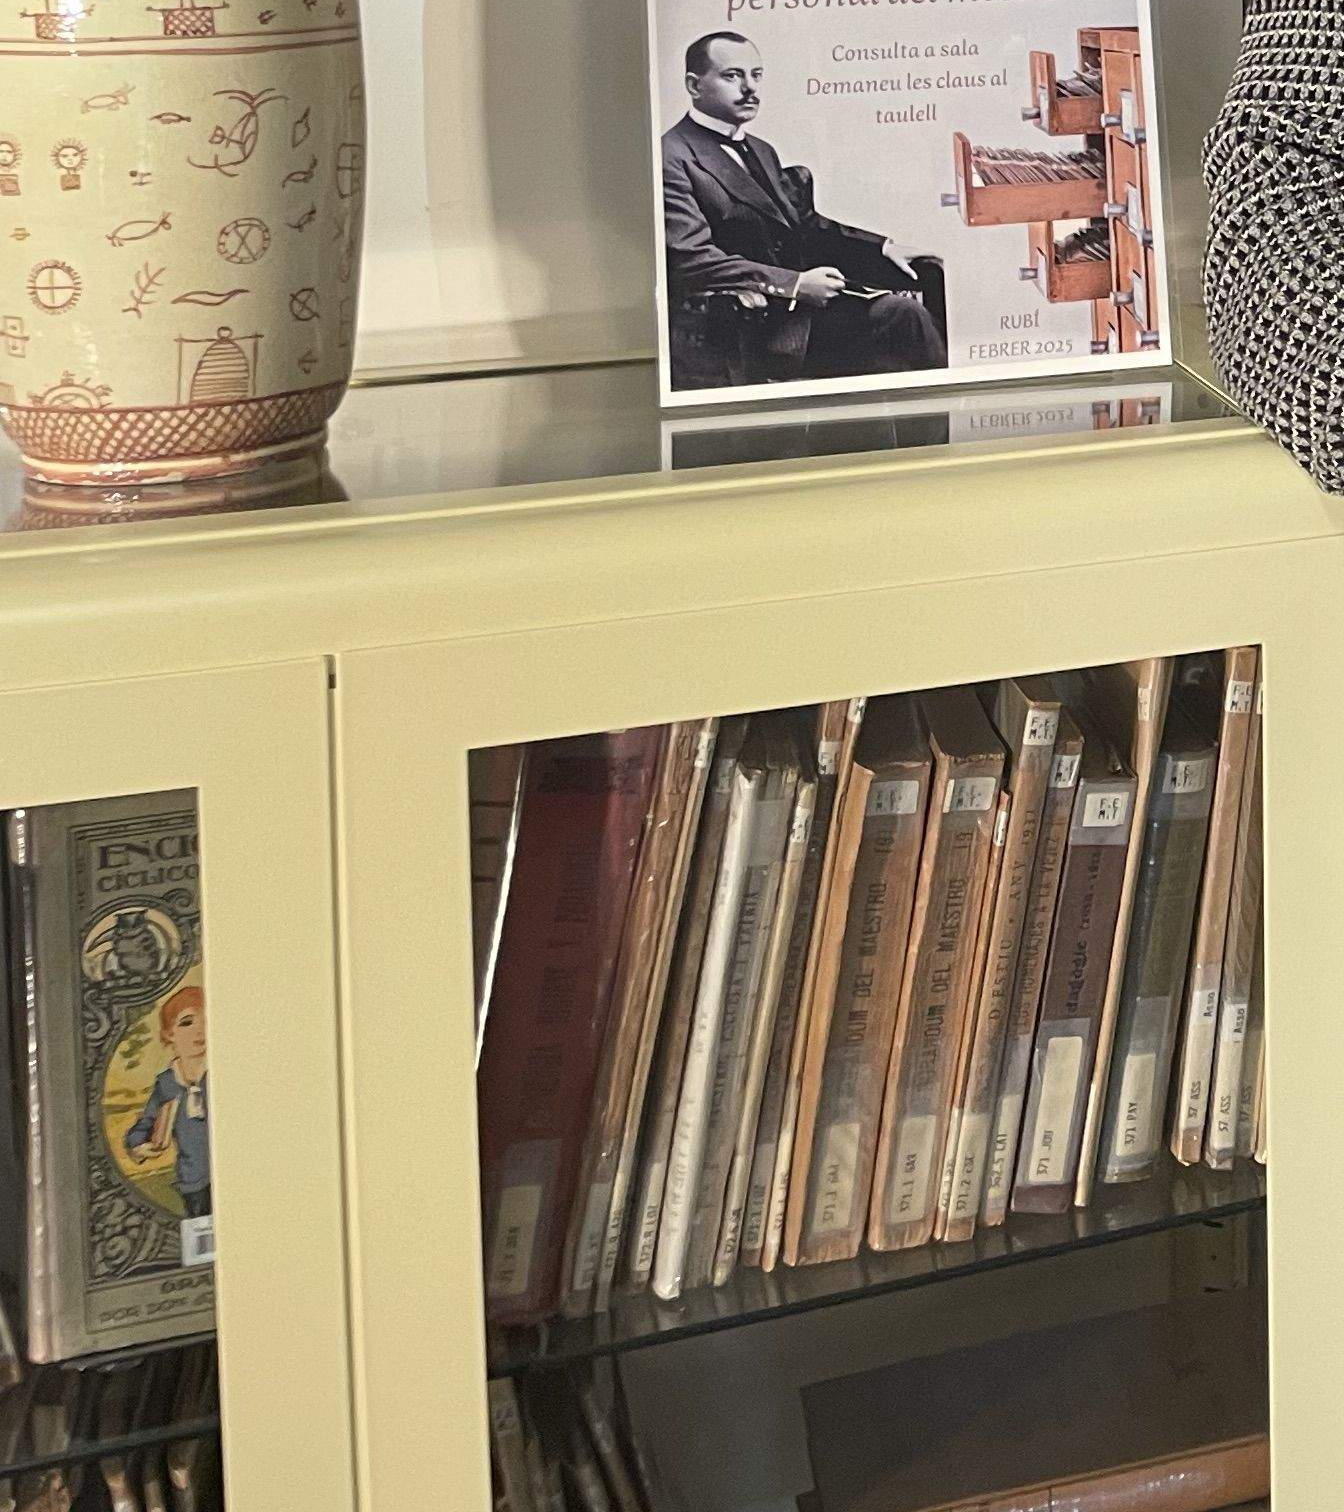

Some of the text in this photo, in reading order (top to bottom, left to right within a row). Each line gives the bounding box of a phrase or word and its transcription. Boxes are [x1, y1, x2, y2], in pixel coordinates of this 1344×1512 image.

[832, 39, 980, 63] Consulta a sala
[806, 68, 1008, 96] Demaneu les claus al
[875, 103, 938, 124] taulell
[999, 309, 1040, 331] RUBÍ
[968, 339, 1074, 359] FEBRER 2025
[98, 834, 198, 870] ENCI
